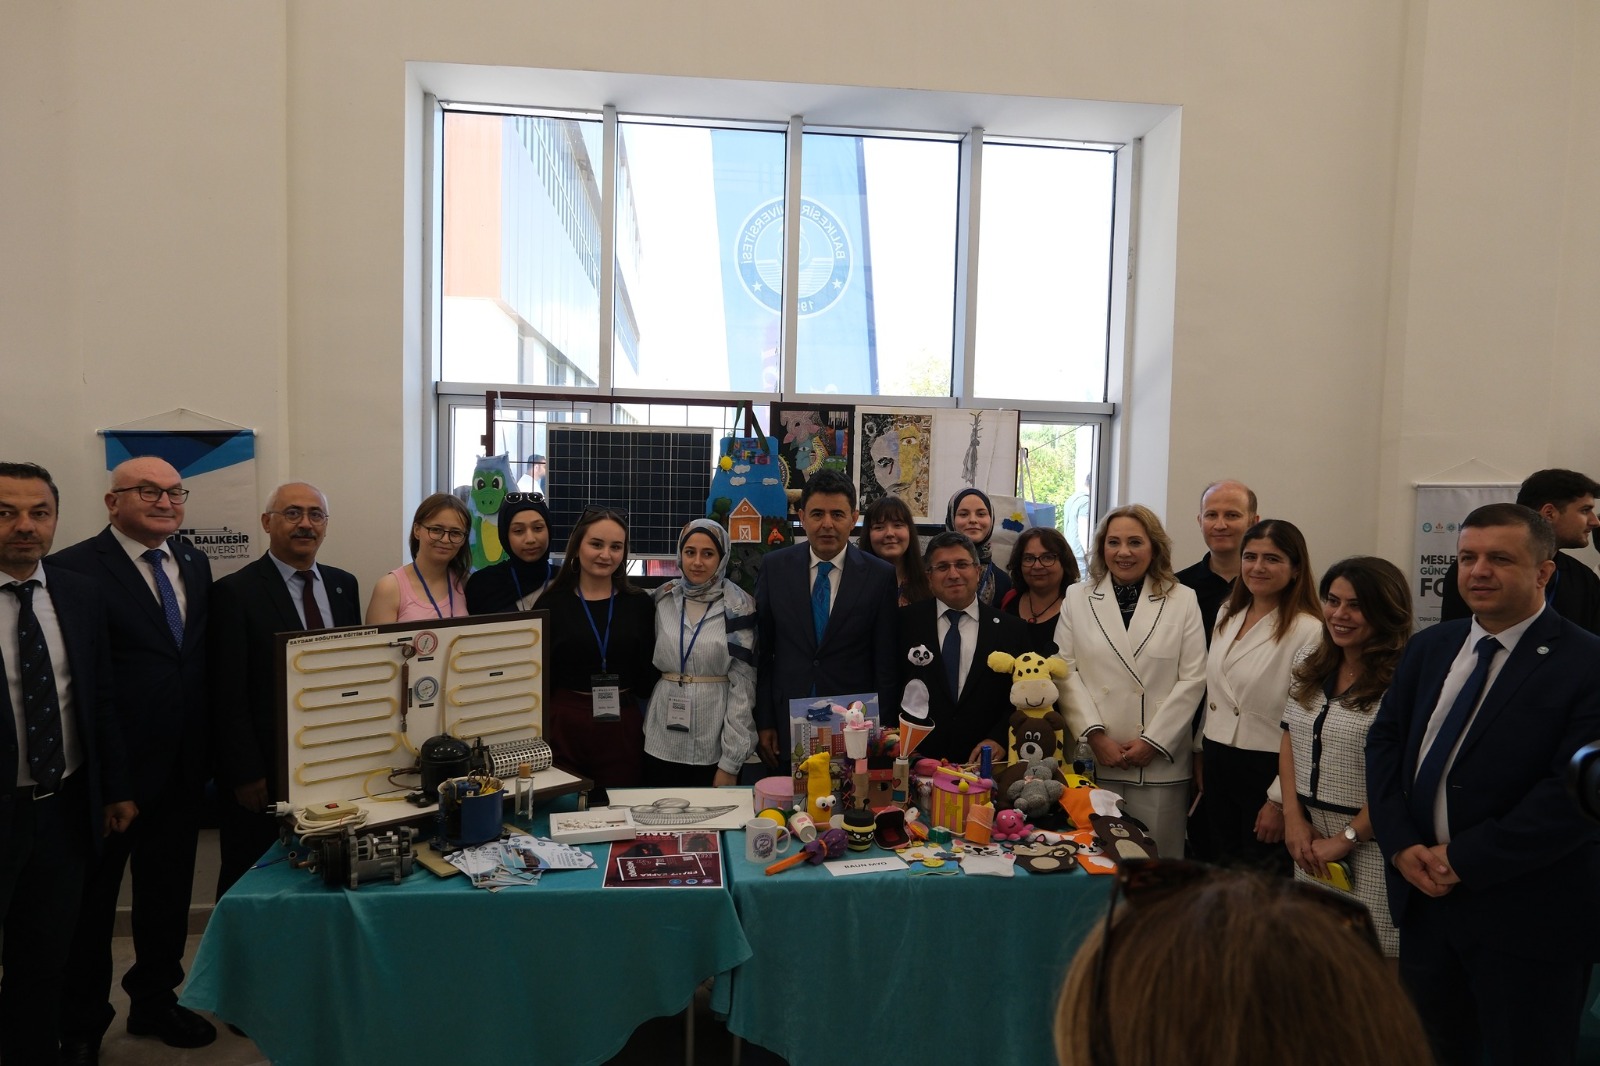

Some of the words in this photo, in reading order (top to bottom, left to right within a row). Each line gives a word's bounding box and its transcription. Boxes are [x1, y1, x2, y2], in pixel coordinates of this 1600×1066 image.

[194, 534, 249, 544] BALIKESİR
[1420, 566, 1447, 576] GÜNC
[1420, 578, 1444, 597] FO
